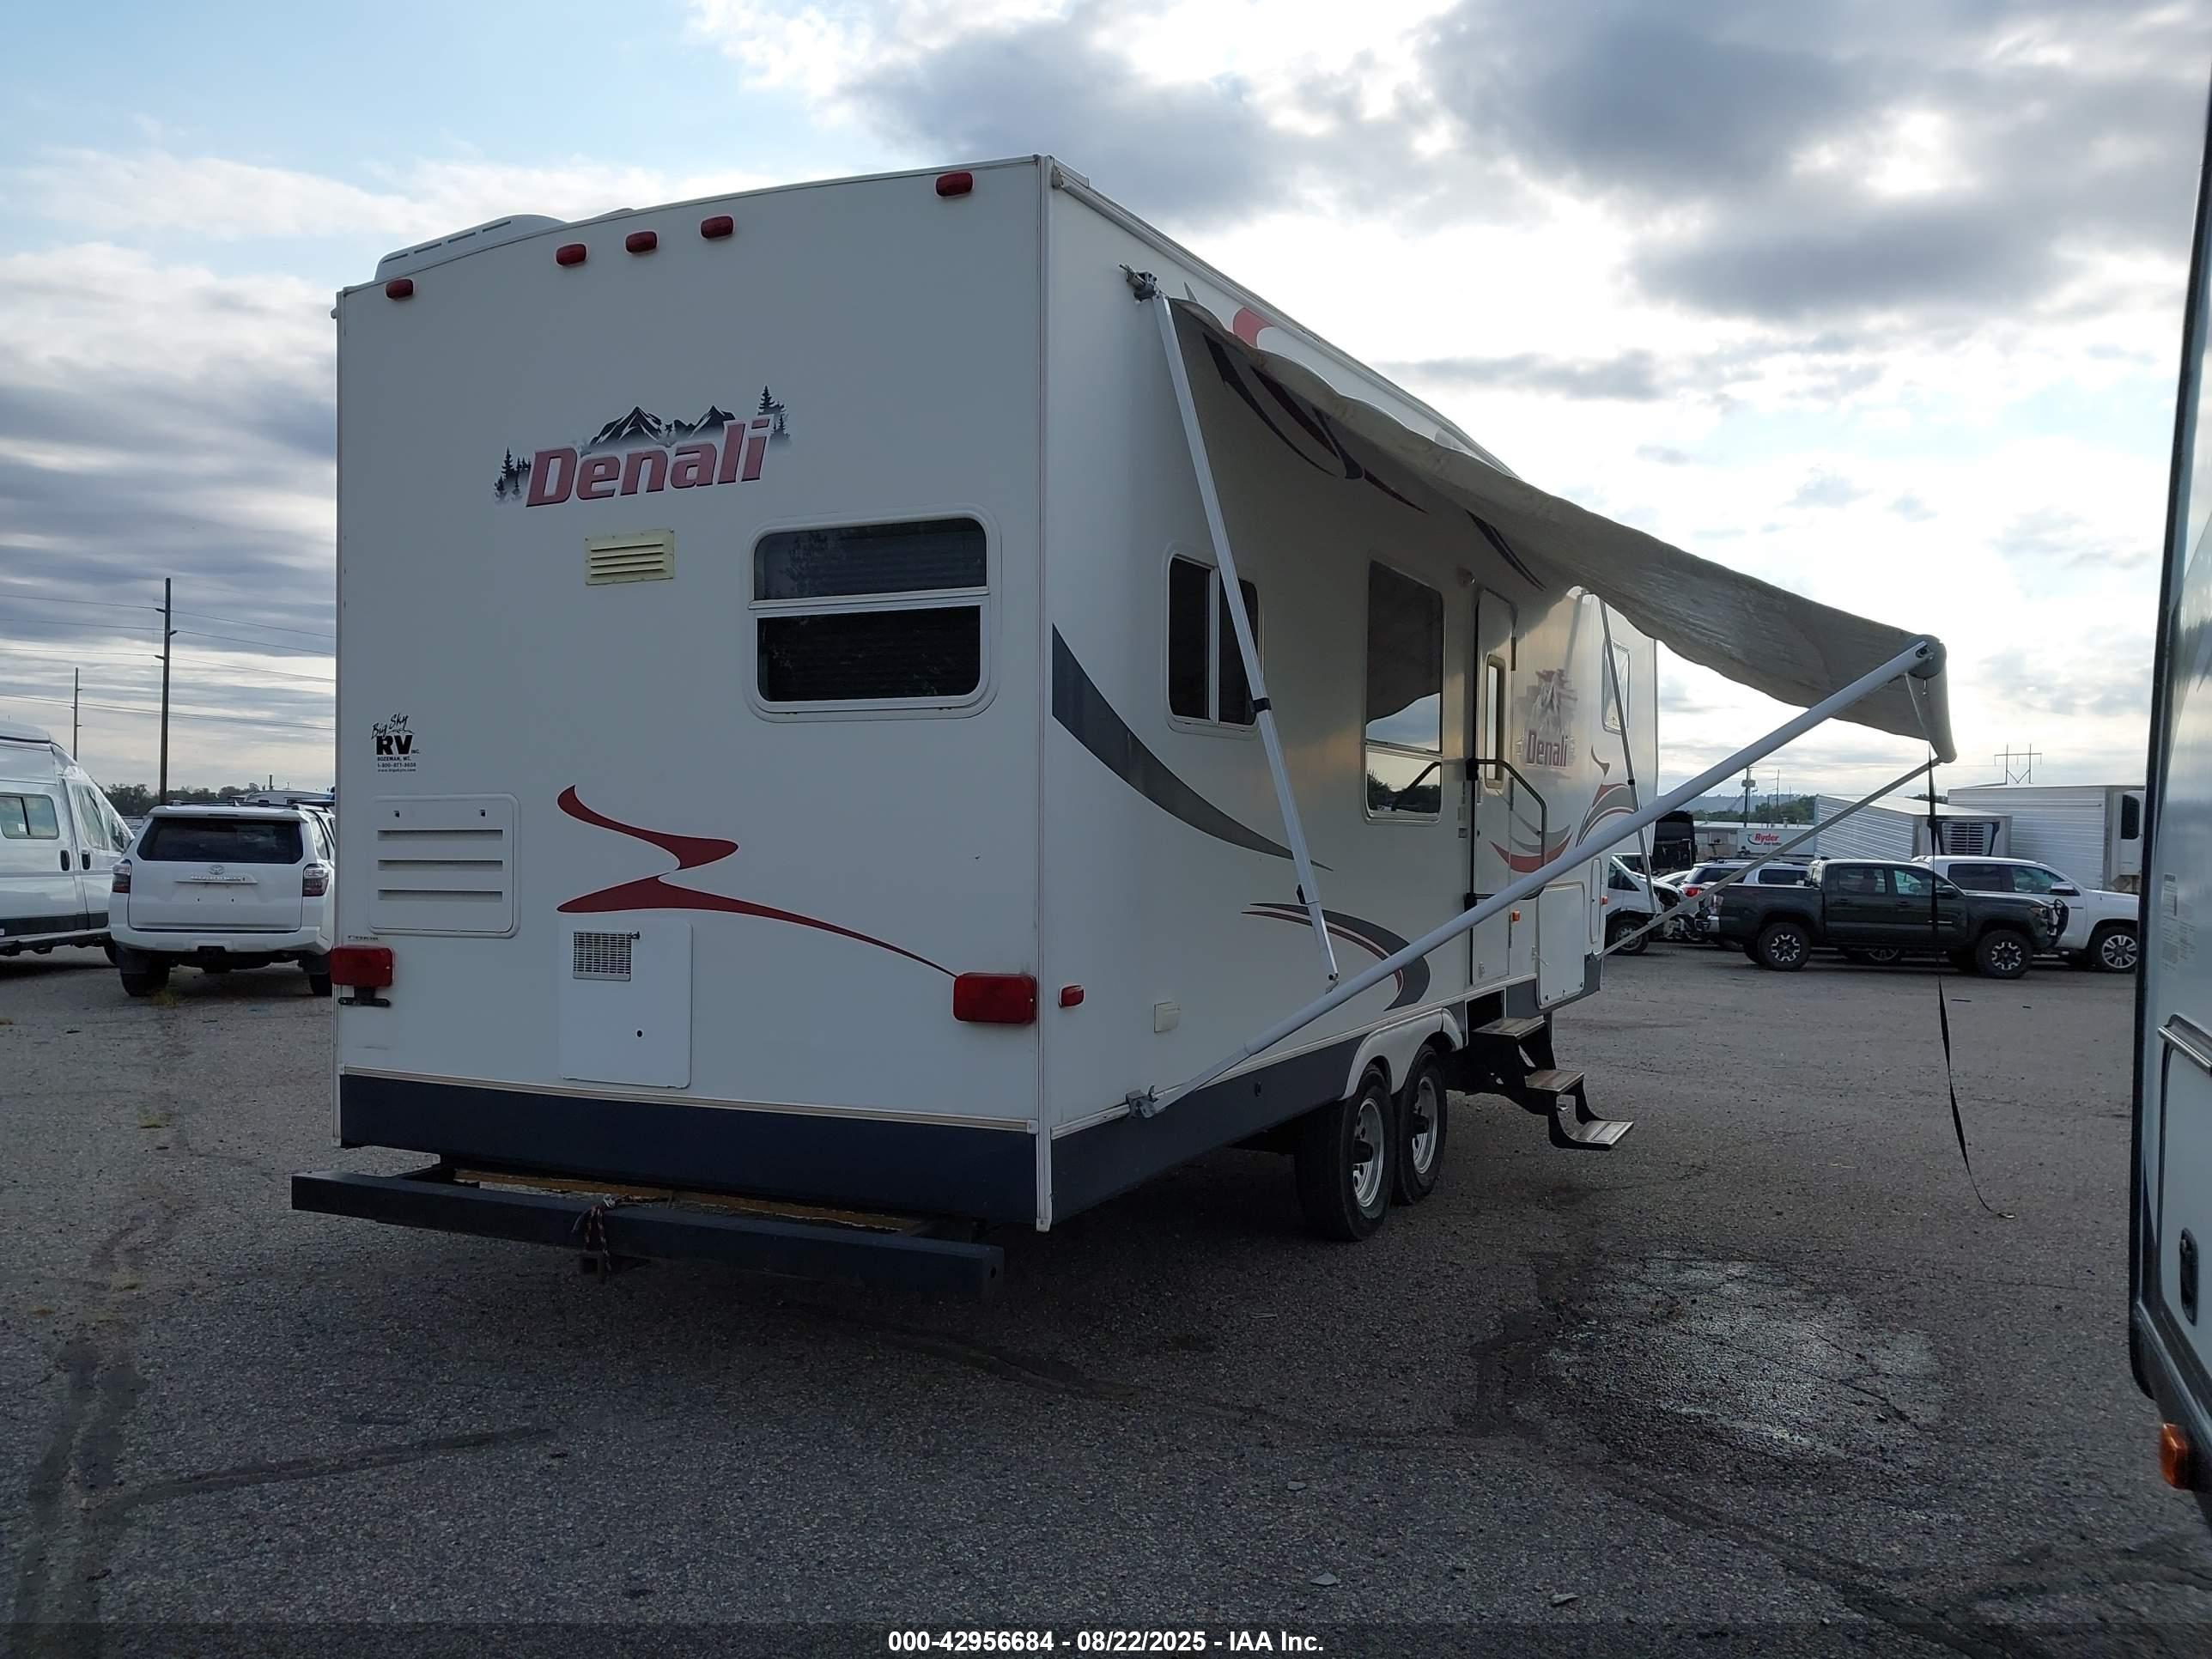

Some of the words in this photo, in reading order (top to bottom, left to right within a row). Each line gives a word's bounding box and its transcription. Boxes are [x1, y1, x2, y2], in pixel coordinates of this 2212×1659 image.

[526, 416, 770, 507] Denali
[389, 713, 408, 730] Sky
[376, 735, 413, 755] RV
[1526, 730, 1568, 768] Denali
[1754, 833, 1779, 842] Ryder
